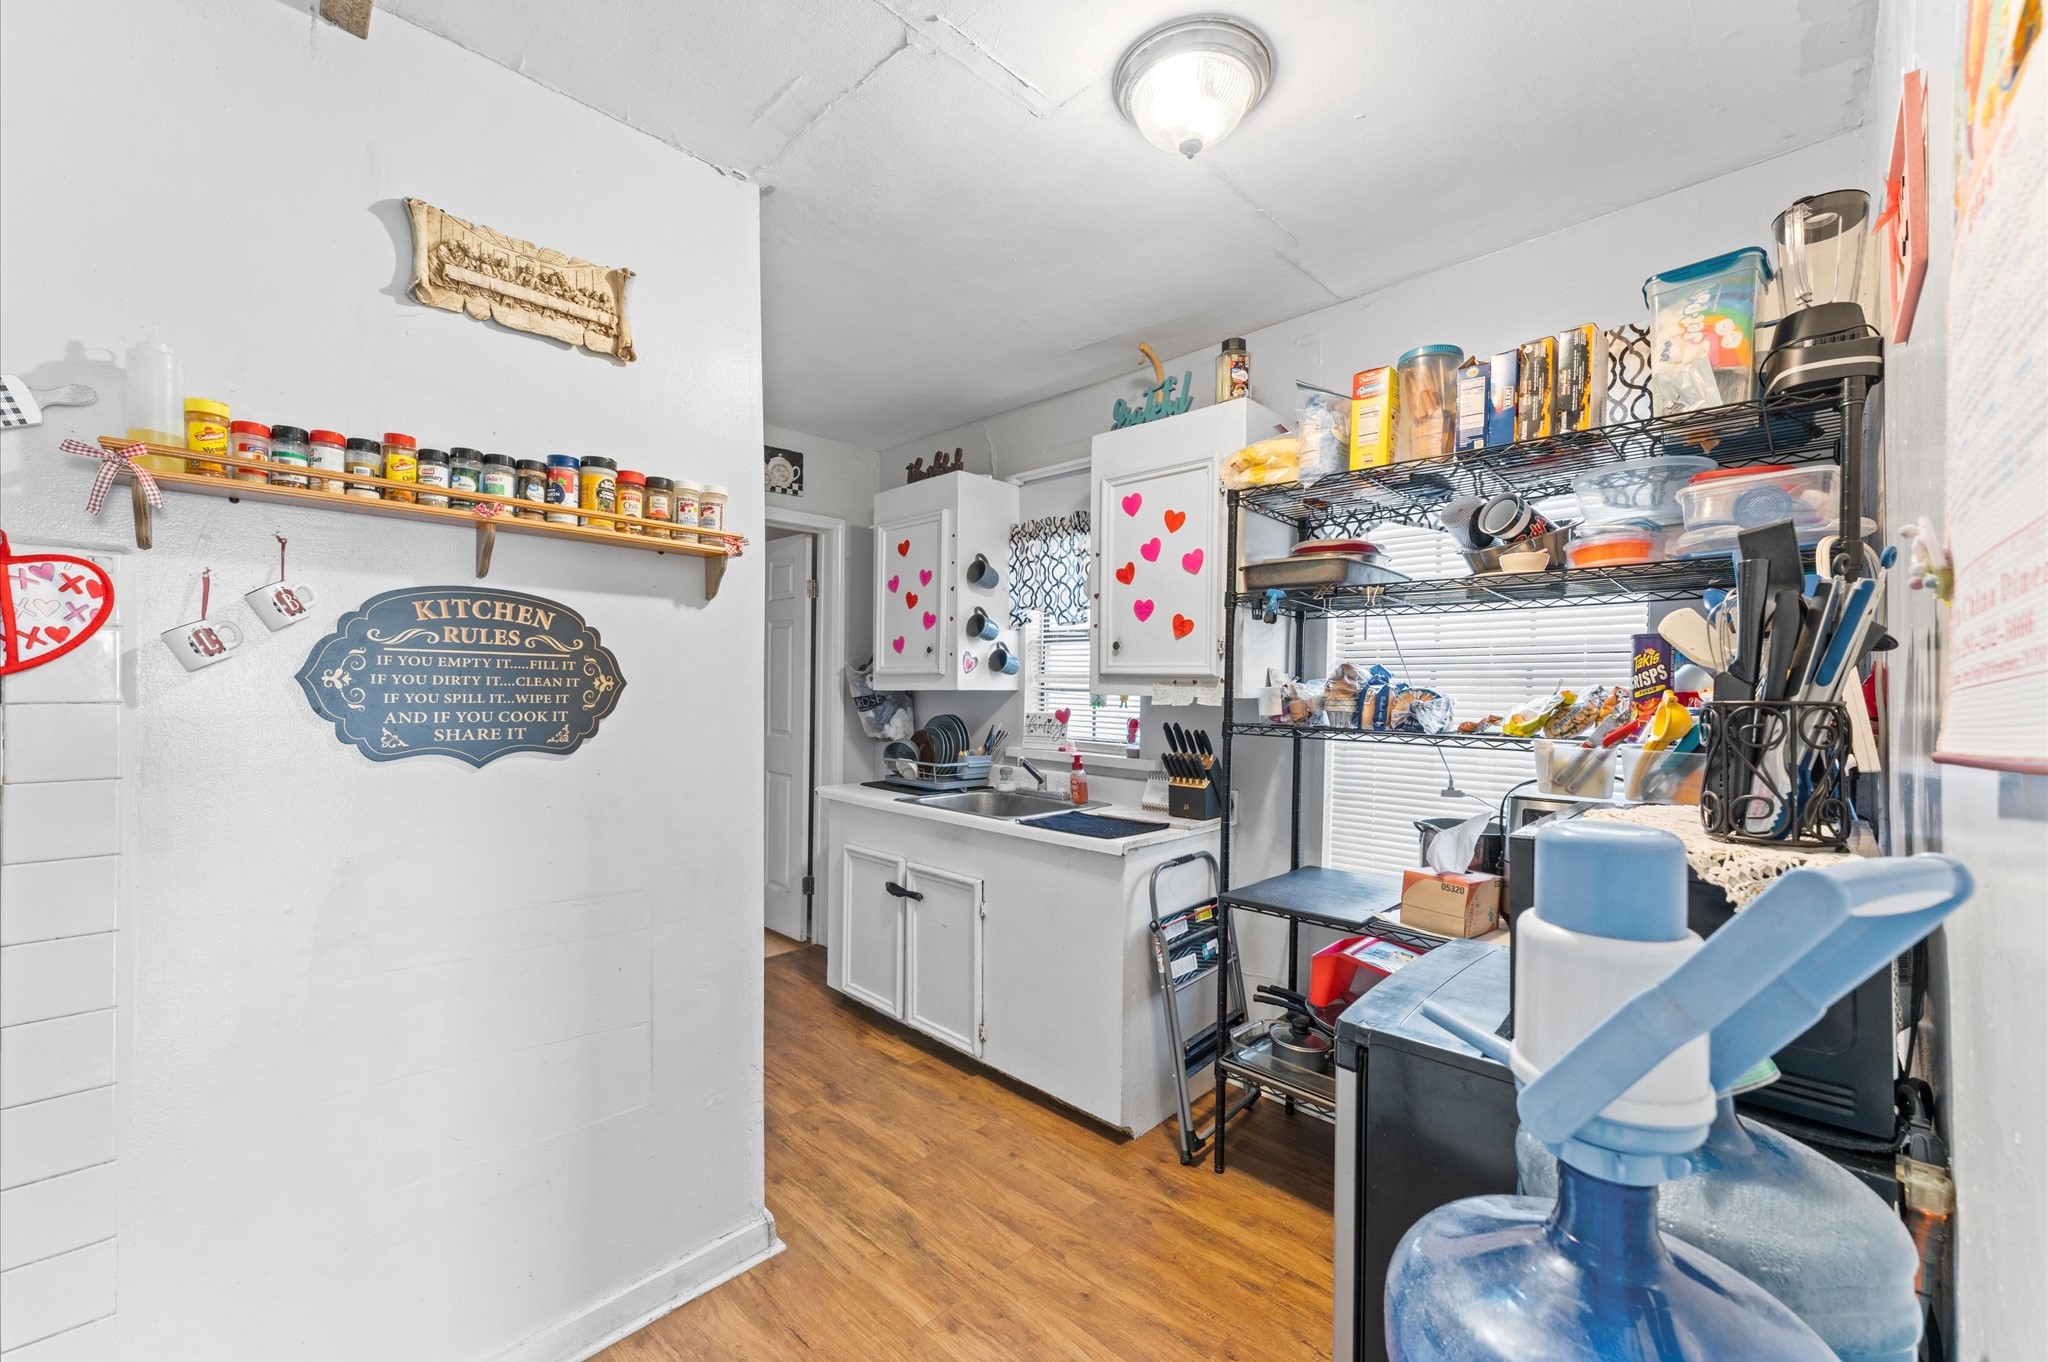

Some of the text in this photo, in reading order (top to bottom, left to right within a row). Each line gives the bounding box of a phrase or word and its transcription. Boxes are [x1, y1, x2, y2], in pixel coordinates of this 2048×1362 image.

[412, 598, 556, 631] KITCHEN
[443, 626, 521, 646] RULES
[376, 655, 393, 666] IF
[398, 655, 434, 667] YOU
[438, 657, 492, 669] EMPTY
[561, 660, 576, 671] IT
[1634, 651, 1661, 672] Takis
[370, 673, 386, 684] IF
[392, 674, 428, 685] YOU
[432, 674, 481, 686] DIRTY
[566, 676, 580, 688] IT
[384, 693, 400, 704] IF
[405, 693, 442, 704] YOU
[444, 693, 487, 704] SPILL
[556, 694, 570, 704] IT
[384, 710, 569, 724] AND IF YOU COOK IT
[434, 727, 527, 742] SHARE IT
[1440, 882, 1465, 894] 05320
